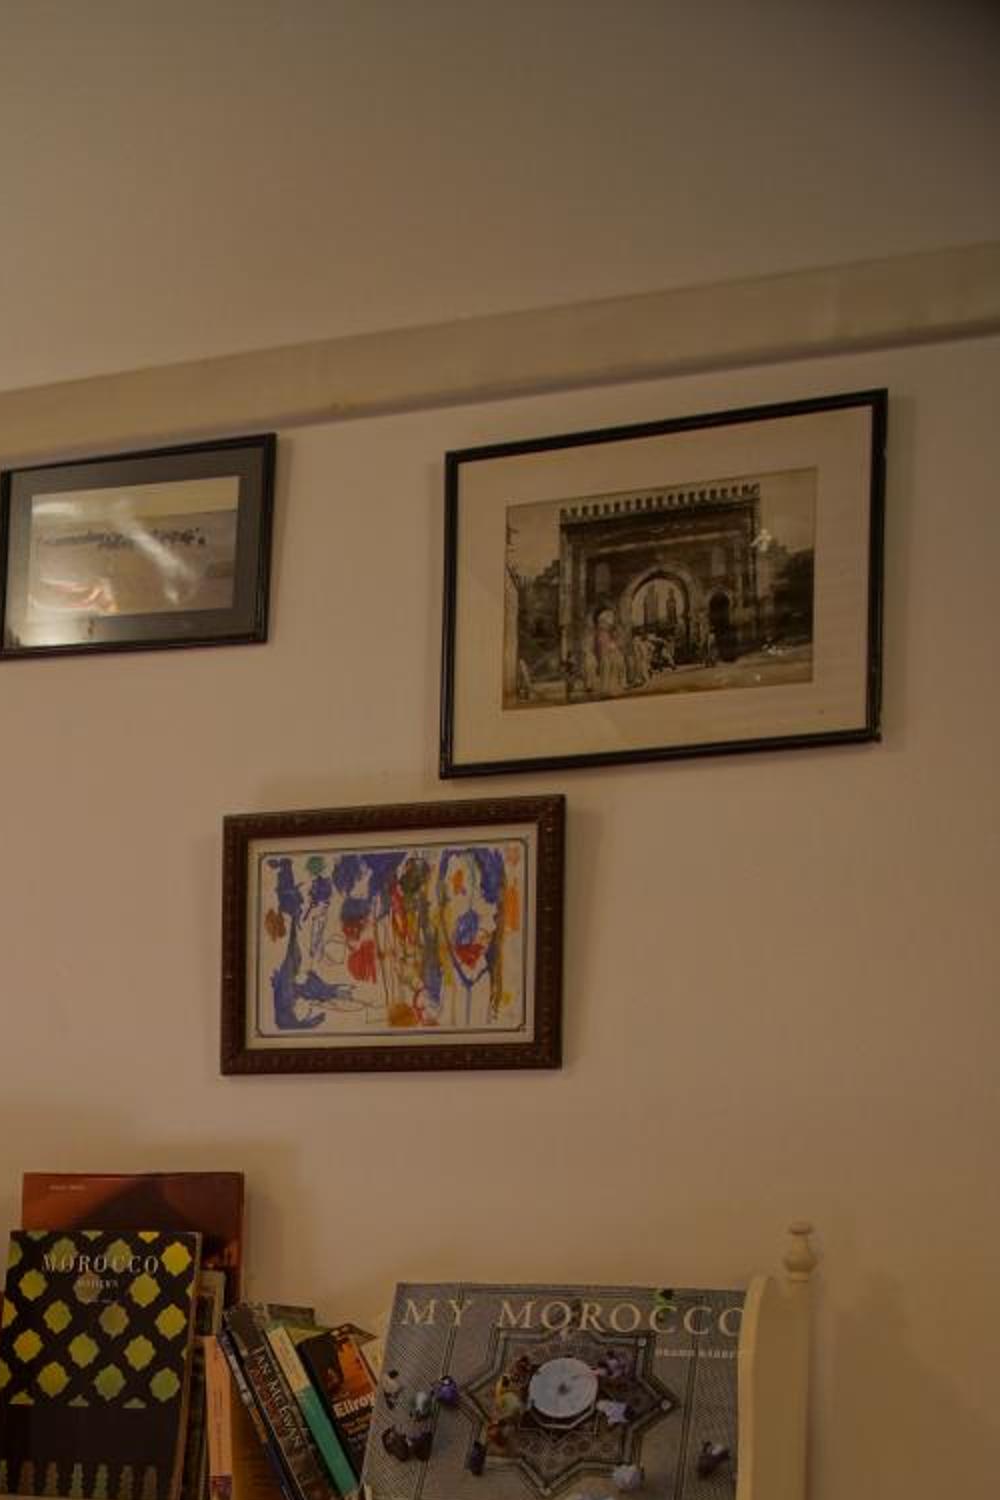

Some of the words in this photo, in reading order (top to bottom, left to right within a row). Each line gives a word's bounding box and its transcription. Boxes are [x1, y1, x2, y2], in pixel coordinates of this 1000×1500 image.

[41, 1253, 160, 1274] MOROCCO
[401, 1298, 473, 1328] MY
[497, 1299, 744, 1338] MOROCCO
[332, 1391, 376, 1417] Ellroy
